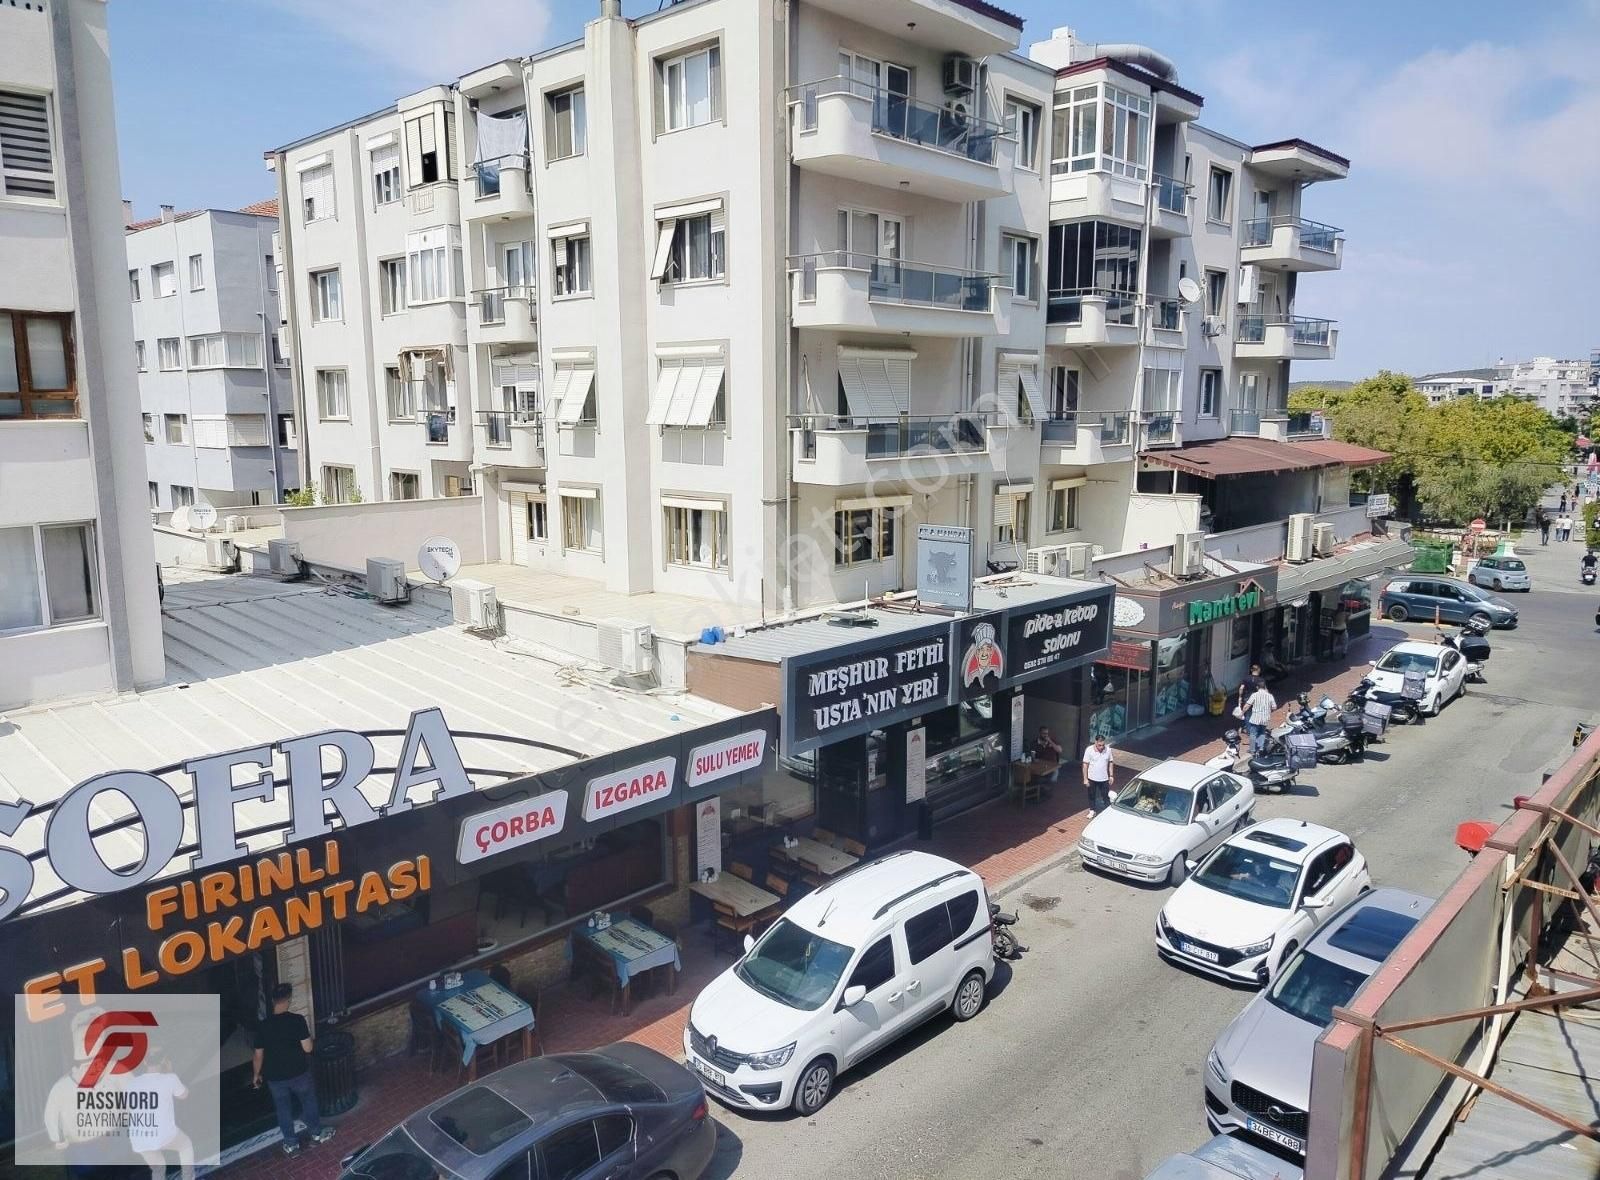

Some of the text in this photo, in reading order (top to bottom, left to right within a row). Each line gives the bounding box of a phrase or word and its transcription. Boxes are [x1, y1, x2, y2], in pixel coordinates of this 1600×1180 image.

[1041, 631, 1081, 654] salonu
[808, 637, 944, 696] MEŞHUR FETHİ
[901, 672, 939, 705] YERİ
[696, 741, 760, 776] SULU YEMEK
[594, 769, 667, 810] IZGARA
[475, 806, 556, 854] ÇORBA
[145, 840, 341, 931] FIRINLI
[23, 957, 107, 1023] ET
[121, 854, 432, 990] LOKANTASI
